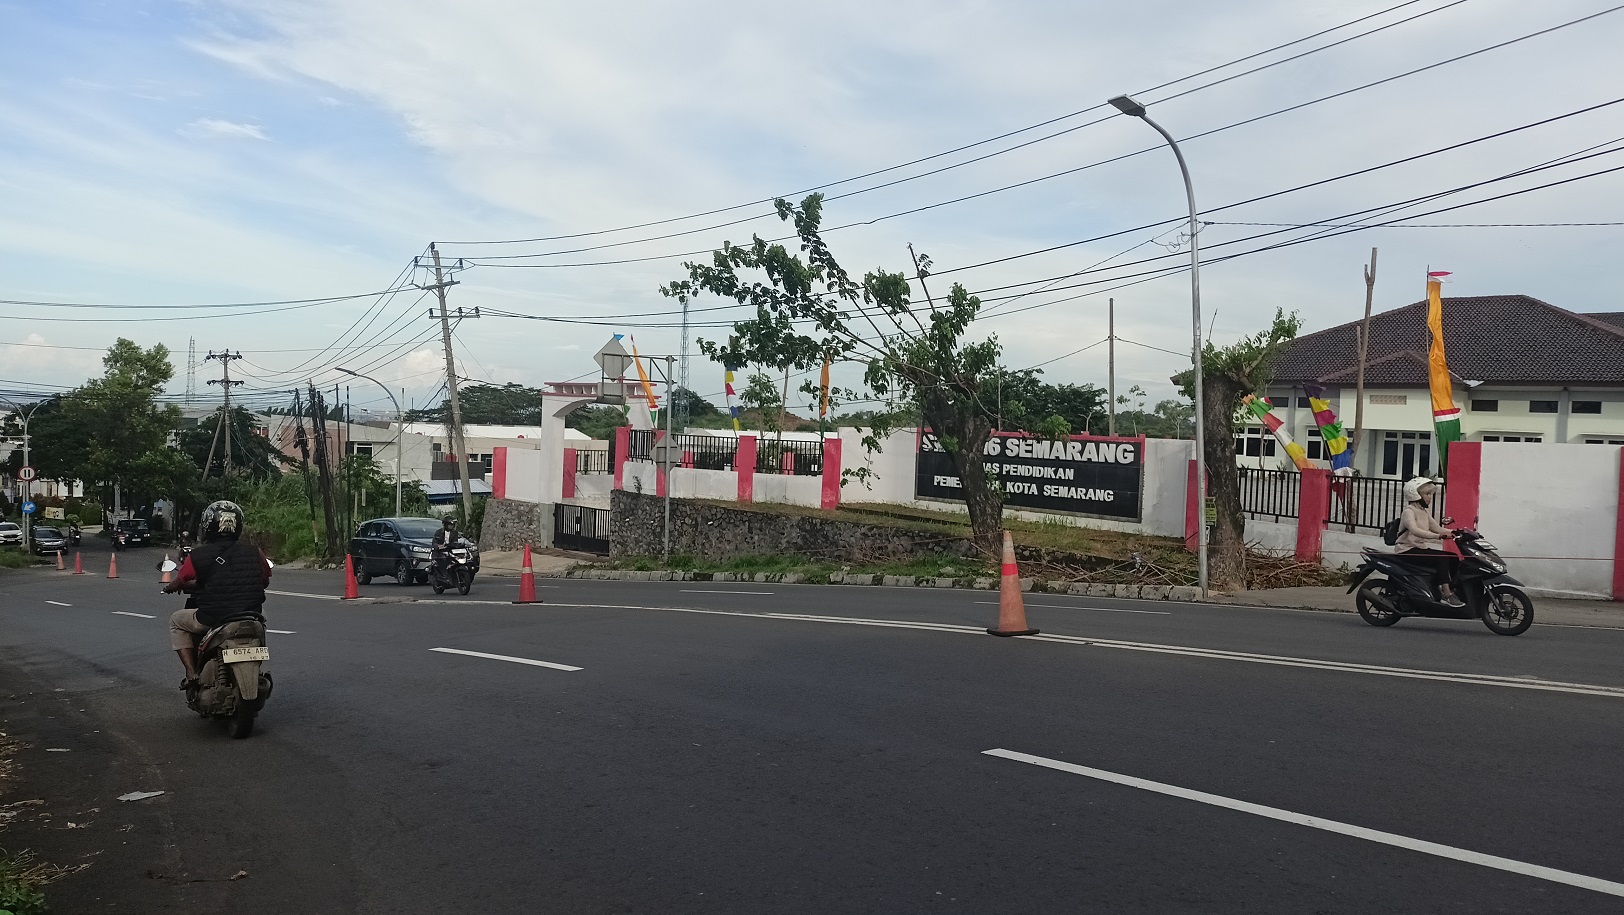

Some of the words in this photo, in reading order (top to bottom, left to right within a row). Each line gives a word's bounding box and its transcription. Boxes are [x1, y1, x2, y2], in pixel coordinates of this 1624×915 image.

[1005, 438, 1135, 464] SEMARANG
[1002, 463, 1075, 480] PENDIDIKAN
[1006, 481, 1038, 496] KOTA
[1043, 484, 1114, 502] SEMARANG
